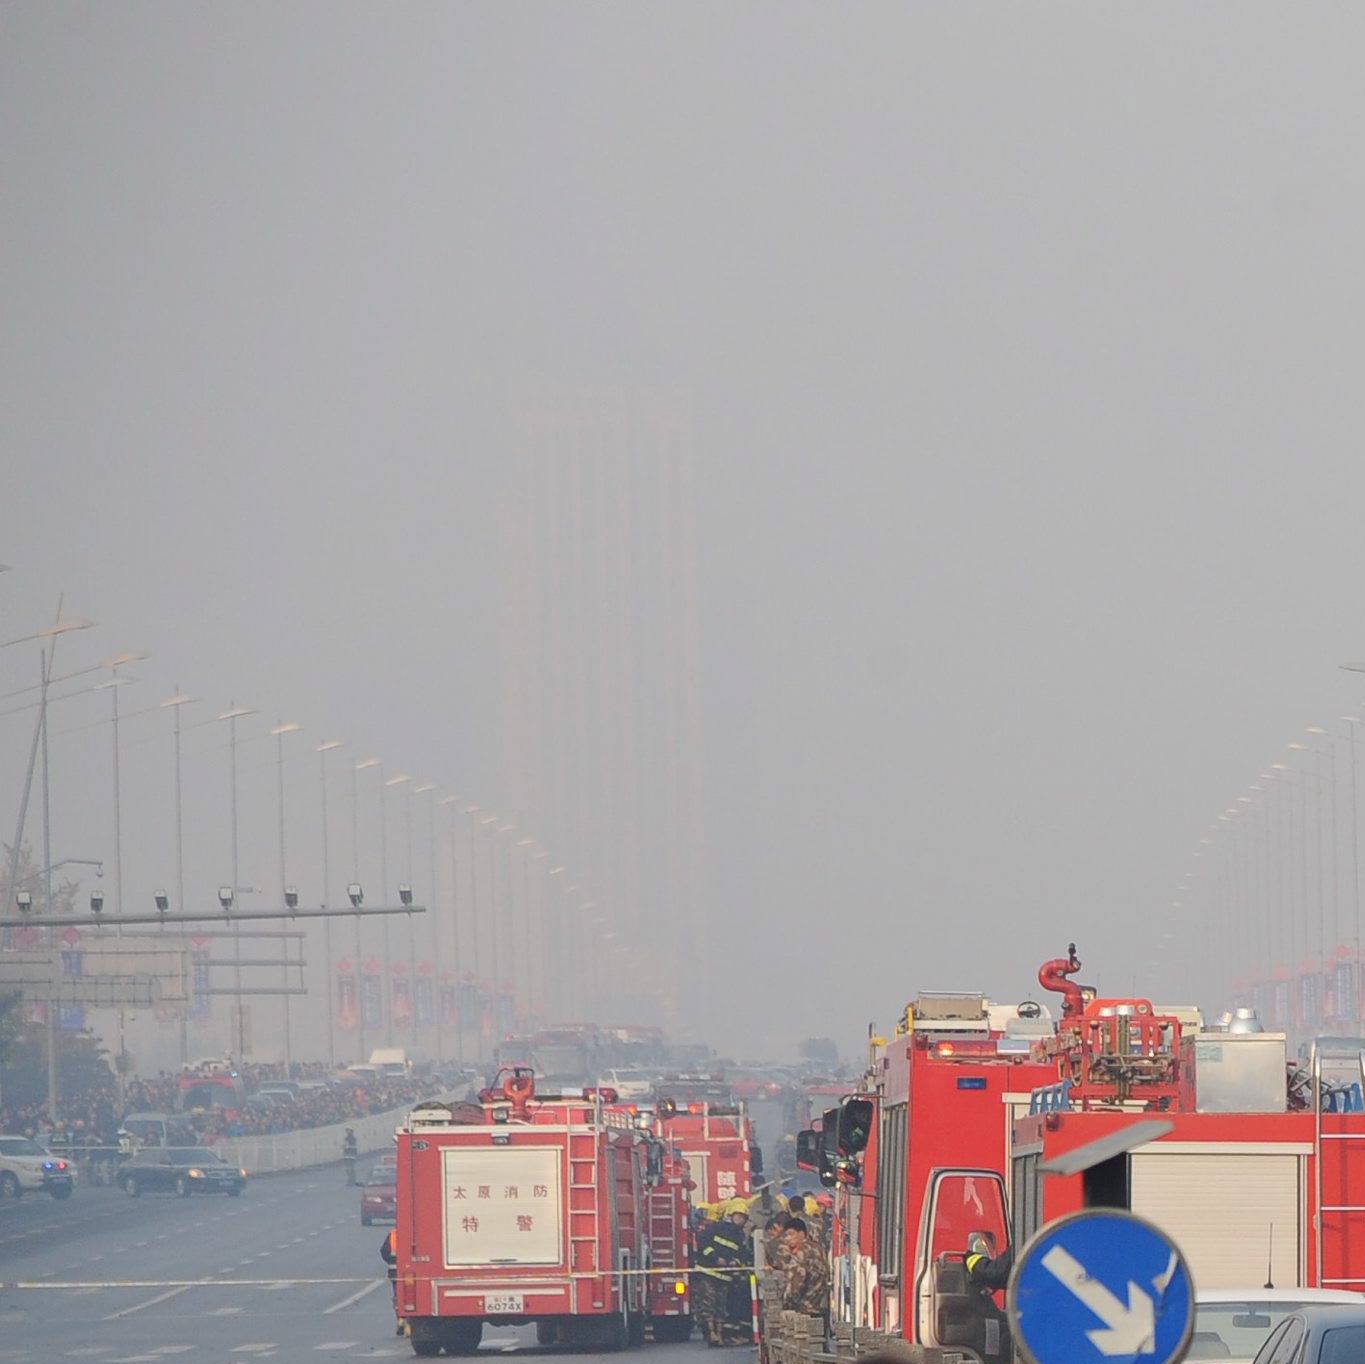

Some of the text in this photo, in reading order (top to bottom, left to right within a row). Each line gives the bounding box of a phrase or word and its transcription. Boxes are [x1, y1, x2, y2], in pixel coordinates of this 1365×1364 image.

[453, 1185, 548, 1199] 太原消防
[462, 1215, 534, 1232] 特警
